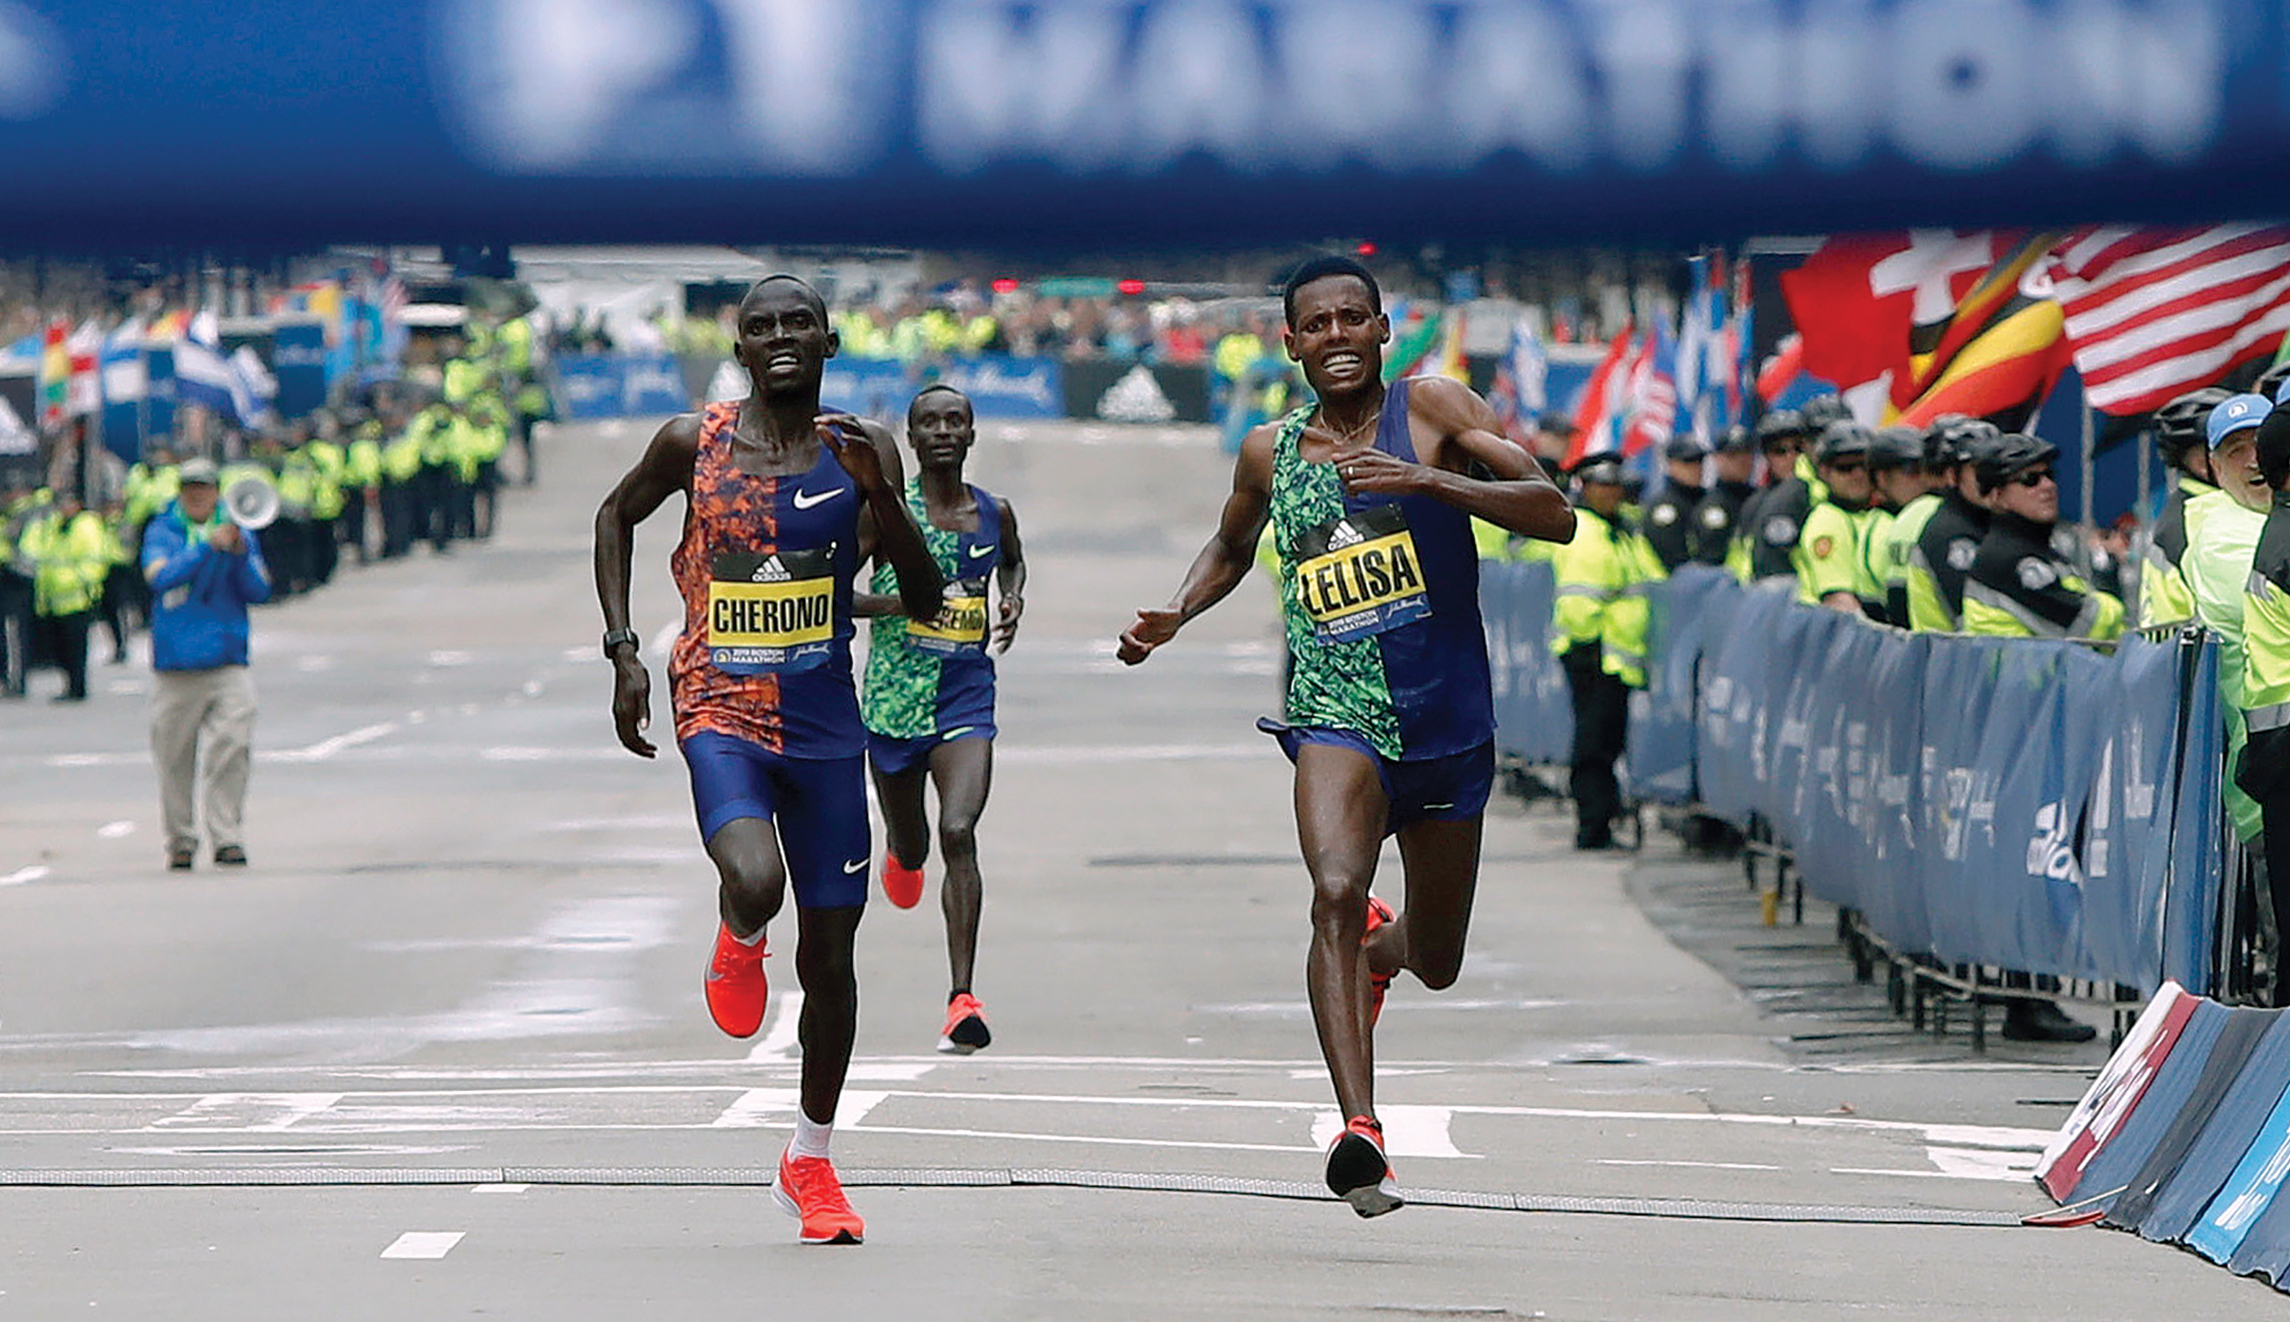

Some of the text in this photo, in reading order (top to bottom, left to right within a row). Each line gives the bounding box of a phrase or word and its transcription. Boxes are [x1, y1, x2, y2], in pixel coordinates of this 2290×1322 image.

[921, 0, 2222, 172] MARATHON
[714, 594, 828, 632] CHERONO
[1301, 545, 1419, 615] LELISA
